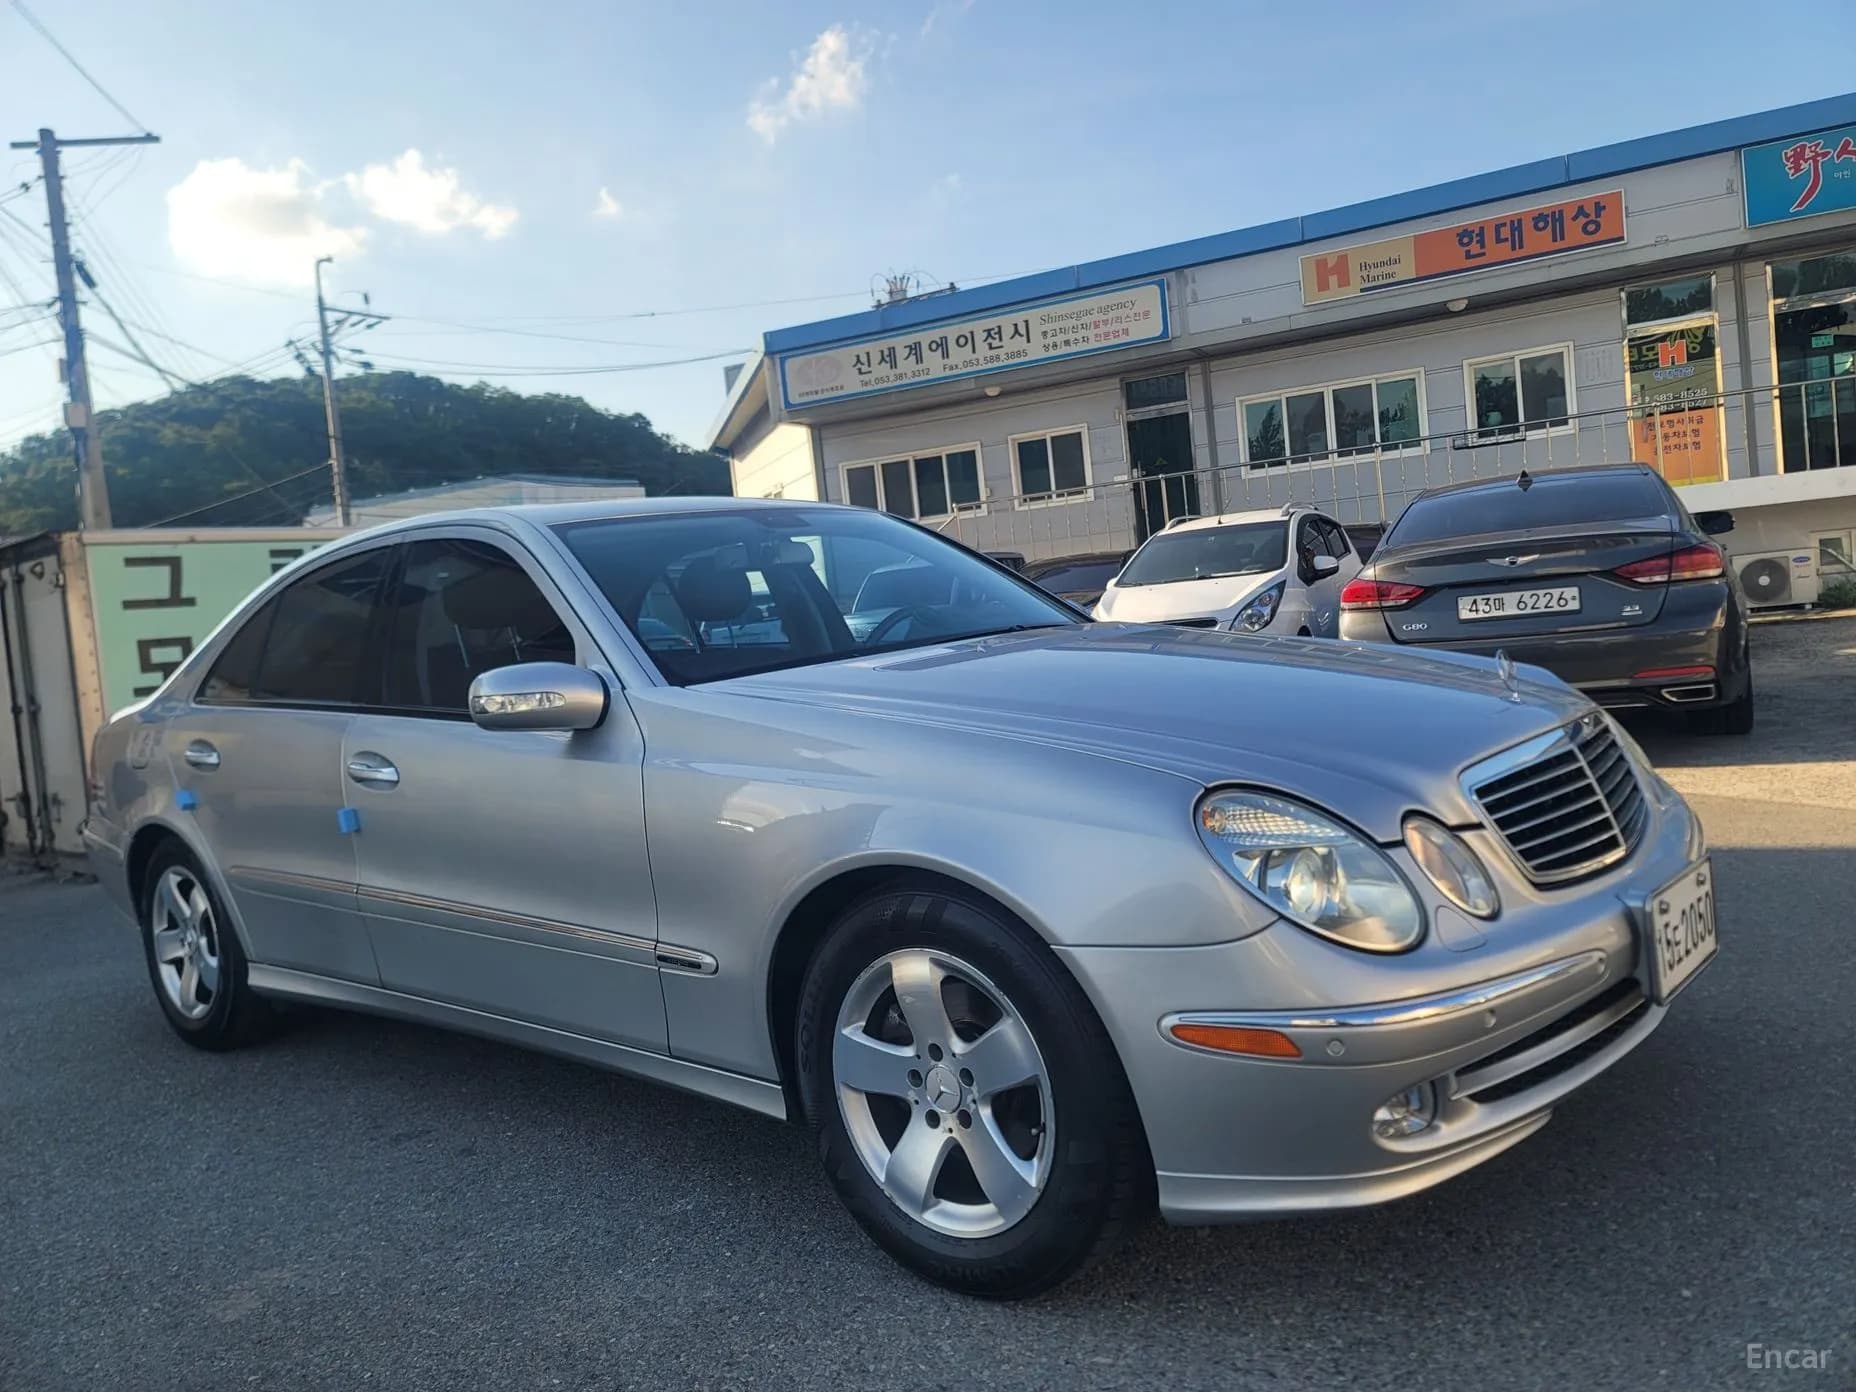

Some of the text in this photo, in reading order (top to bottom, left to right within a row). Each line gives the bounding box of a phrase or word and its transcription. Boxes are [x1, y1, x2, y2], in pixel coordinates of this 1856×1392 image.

[1456, 201, 1606, 260] 현대해상
[1359, 255, 1401, 273] Hyundai
[1360, 271, 1397, 285] Marine
[1039, 299, 1137, 326] Shinsegae agency
[851, 319, 1031, 376] 신세계에이전시
[1468, 591, 1569, 615] 43마 6226
[1402, 623, 1428, 631] G80
